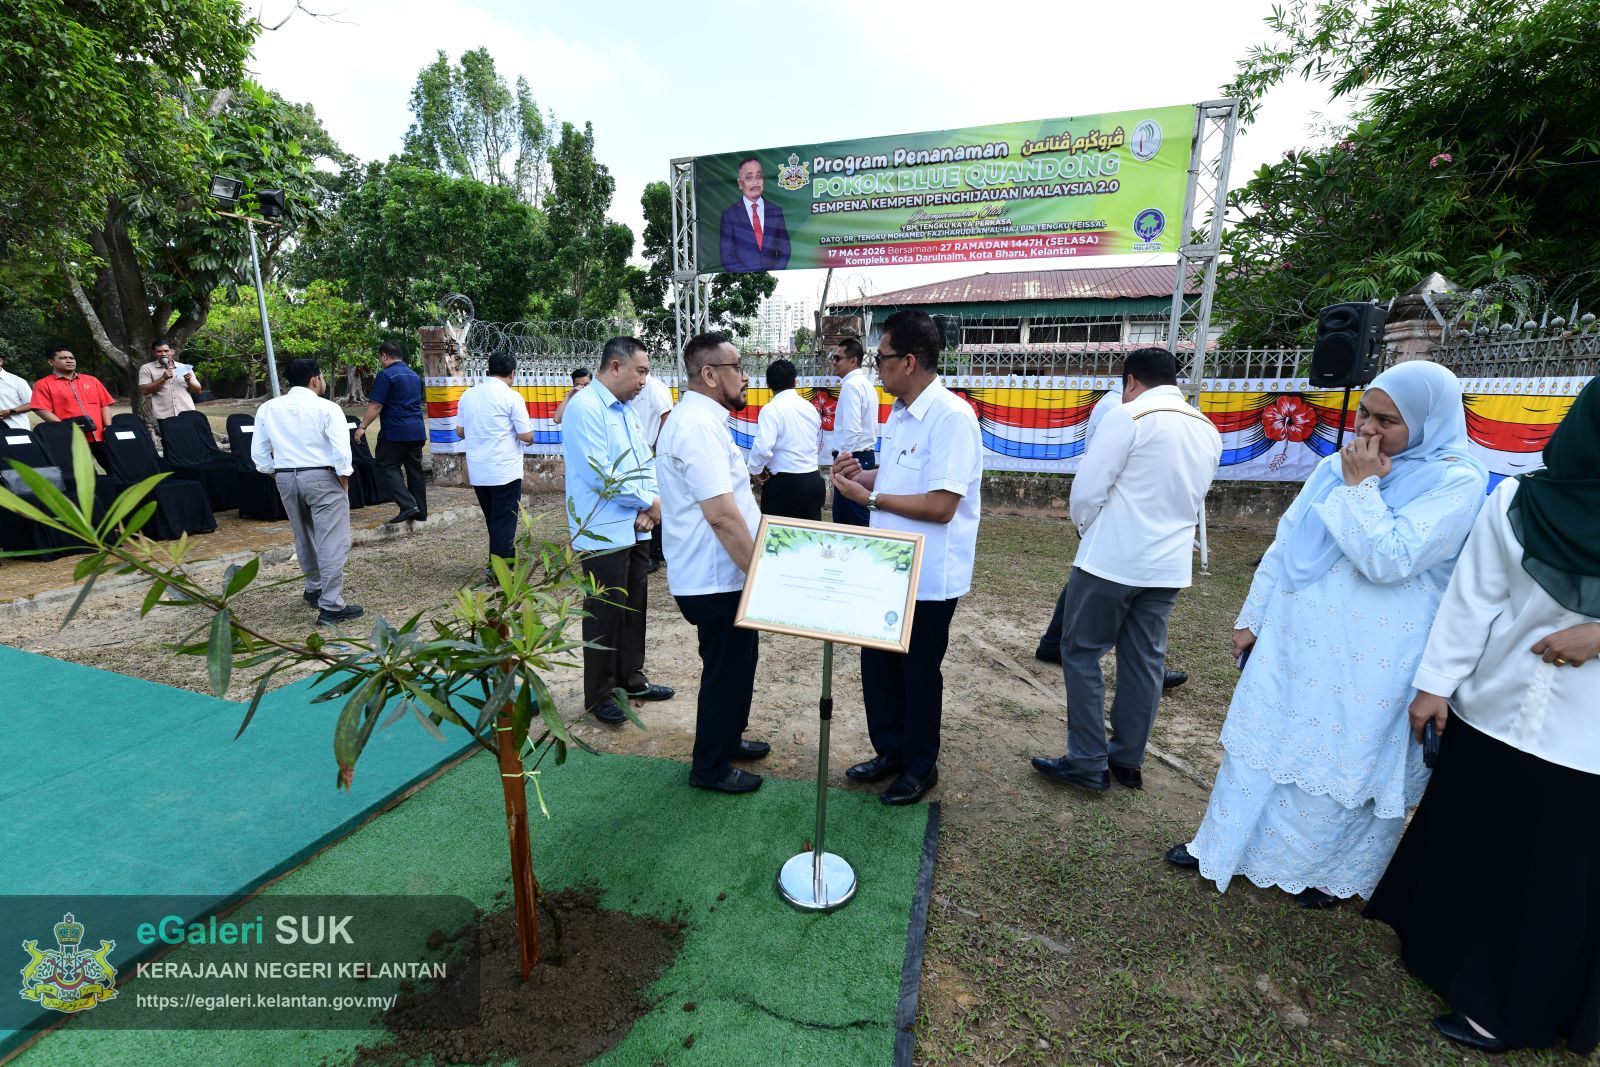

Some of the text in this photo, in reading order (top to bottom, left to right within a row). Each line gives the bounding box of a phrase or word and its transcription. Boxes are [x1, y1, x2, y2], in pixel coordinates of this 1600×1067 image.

[813, 142, 1009, 176] Program Penanaman
[813, 152, 1120, 198] POKOK BLUE QUANDONG
[812, 179, 1119, 214] SEMPENA KEMPEN PENGHIJAUAN MALAYSIA 2.0
[843, 235, 856, 243] DR.
[857, 233, 886, 241] TENGKU
[887, 231, 926, 239] MOHAMED
[1037, 222, 1070, 230] TENGKU
[1071, 220, 1107, 229] FEISSAL
[919, 222, 950, 230] TENGKU
[951, 220, 973, 228] KAYA
[975, 218, 1012, 227] PERKASA
[827, 236, 1099, 257] 17 MAC 2026 Bersamaan 27 RAMADAN 1447H (SELASA)
[845, 247, 1077, 265] Kompleks Kota Darulnaim, Kota Bharu, Kelantan
